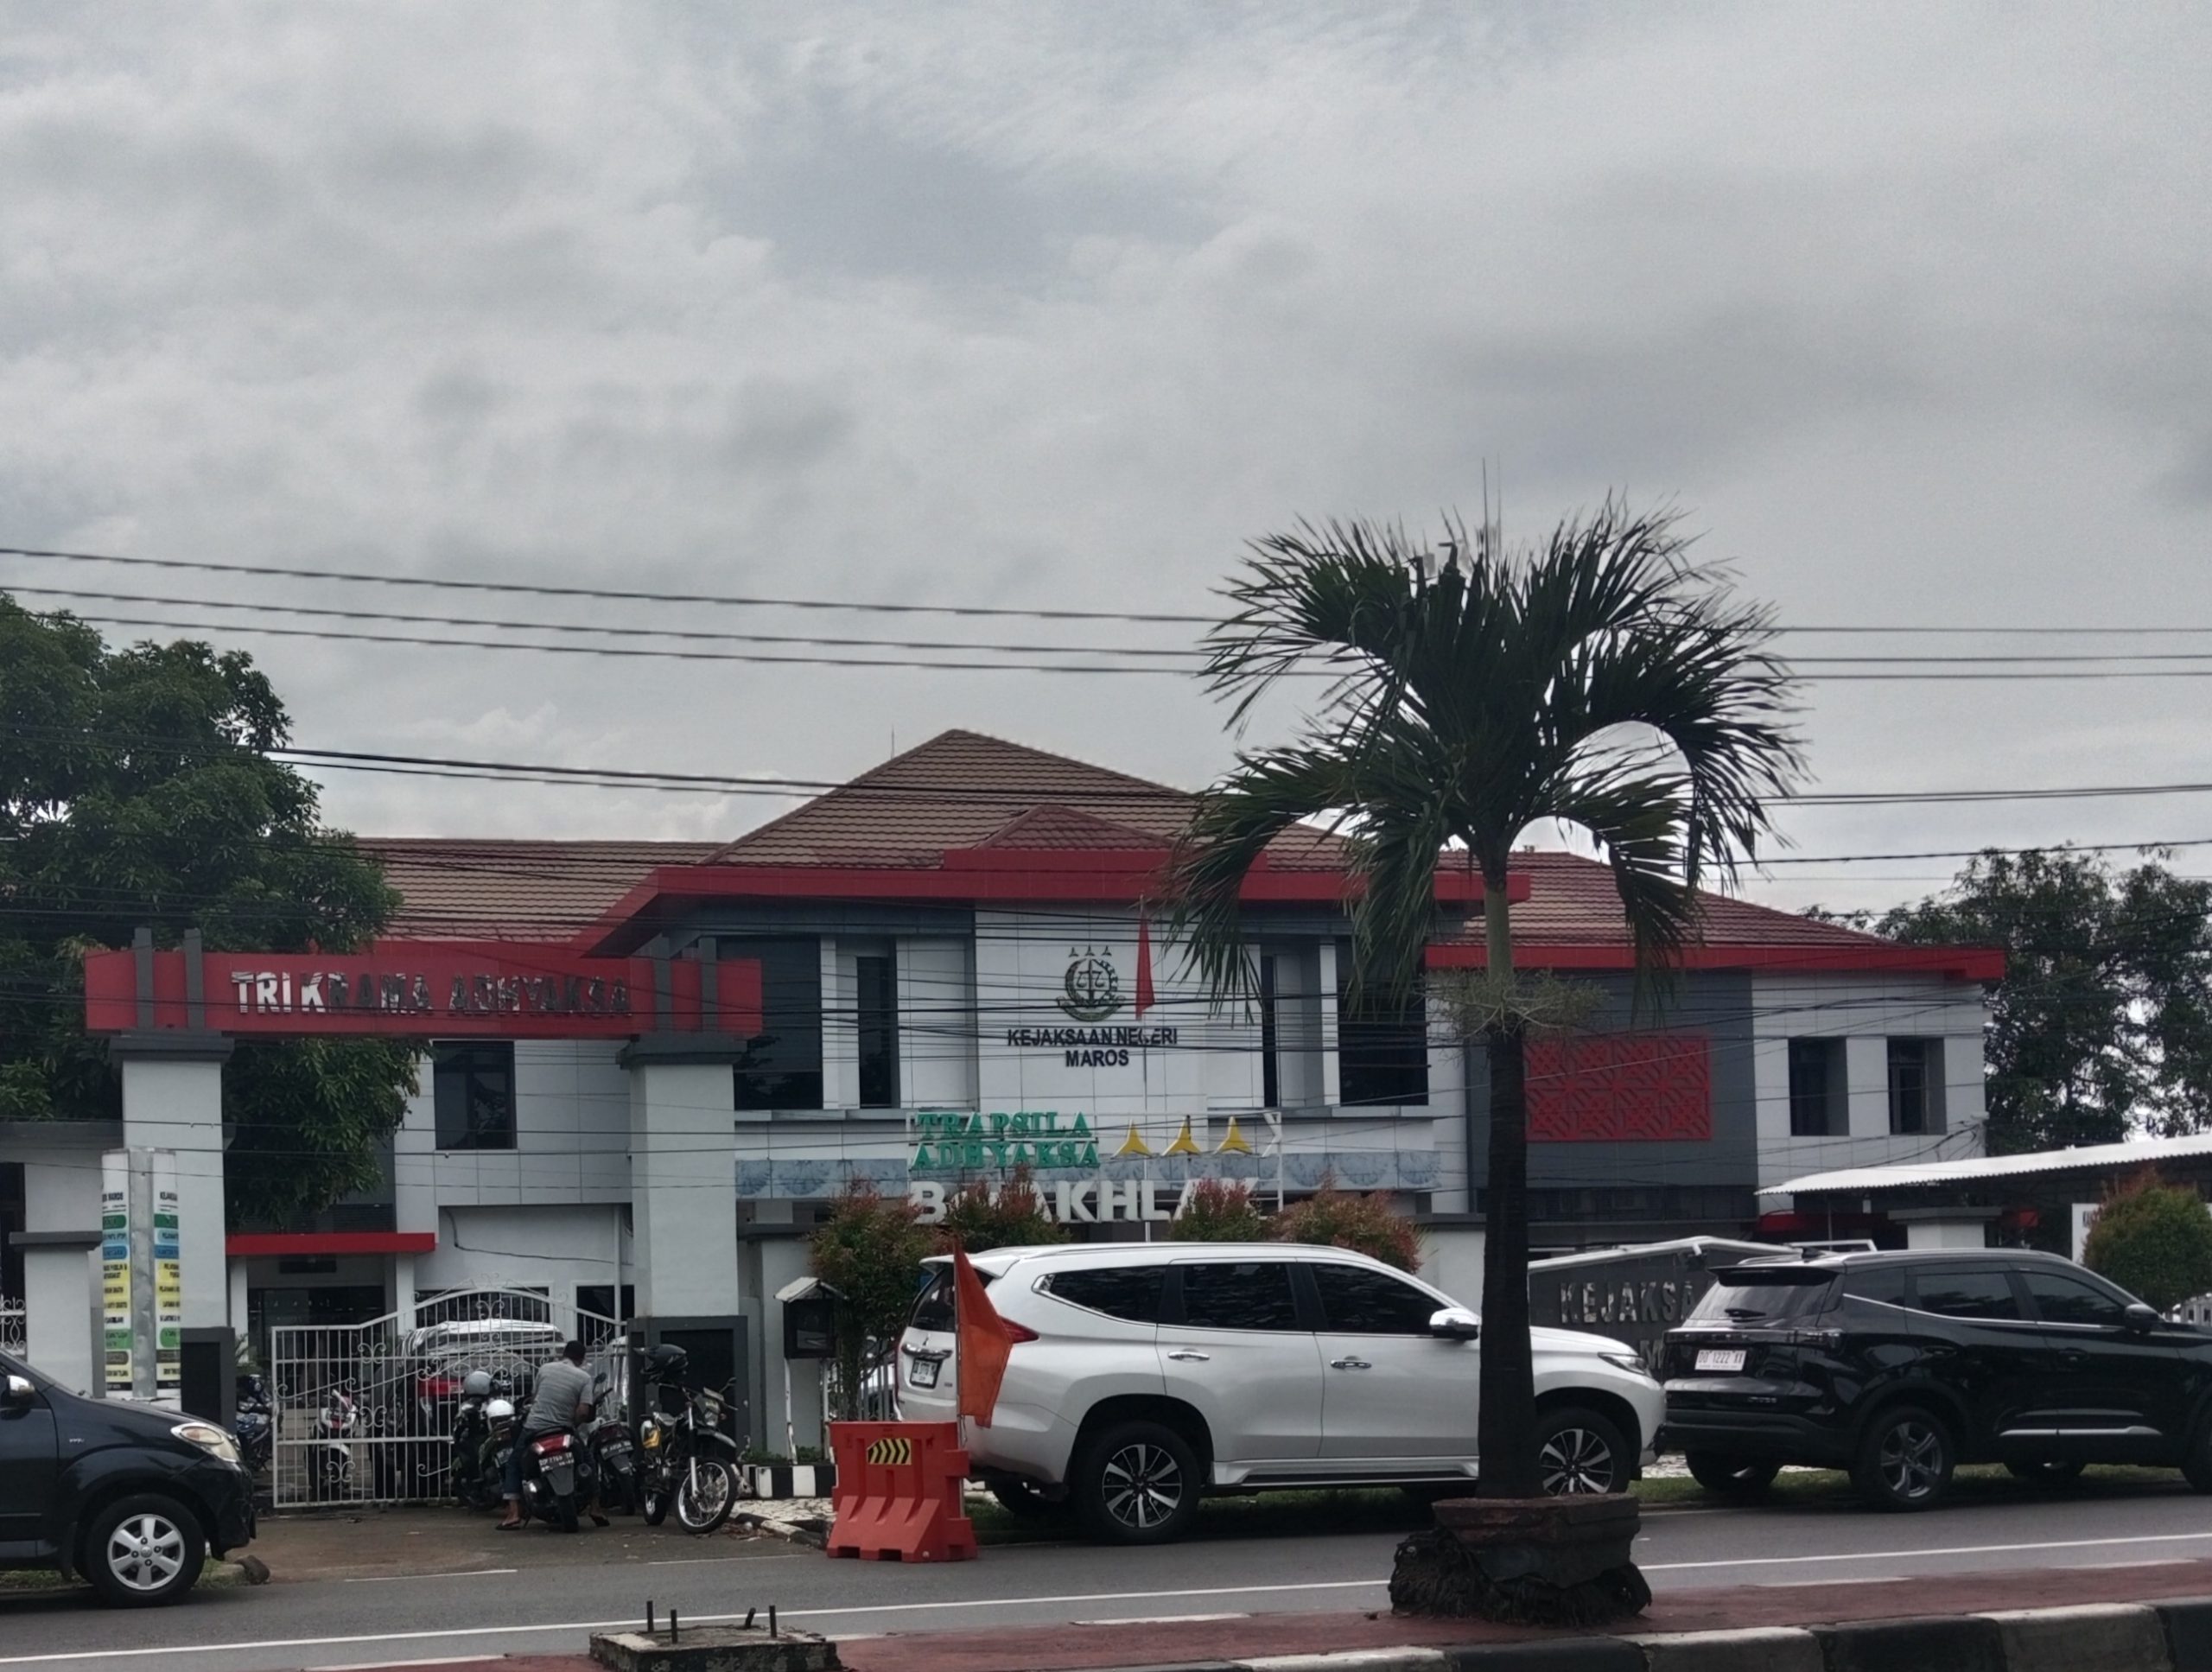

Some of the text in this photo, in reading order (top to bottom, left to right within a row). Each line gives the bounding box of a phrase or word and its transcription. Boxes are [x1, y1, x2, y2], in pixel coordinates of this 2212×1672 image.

[231, 971, 634, 1018] TRI KRAMA ADHYAKSA
[1007, 1027, 1179, 1047] KEJAKSAAN NEGERI
[1065, 1049, 1130, 1068] MAROS
[916, 1111, 1092, 1140] TRAPSILA
[912, 1140, 1102, 1170] ADHYAKSA
